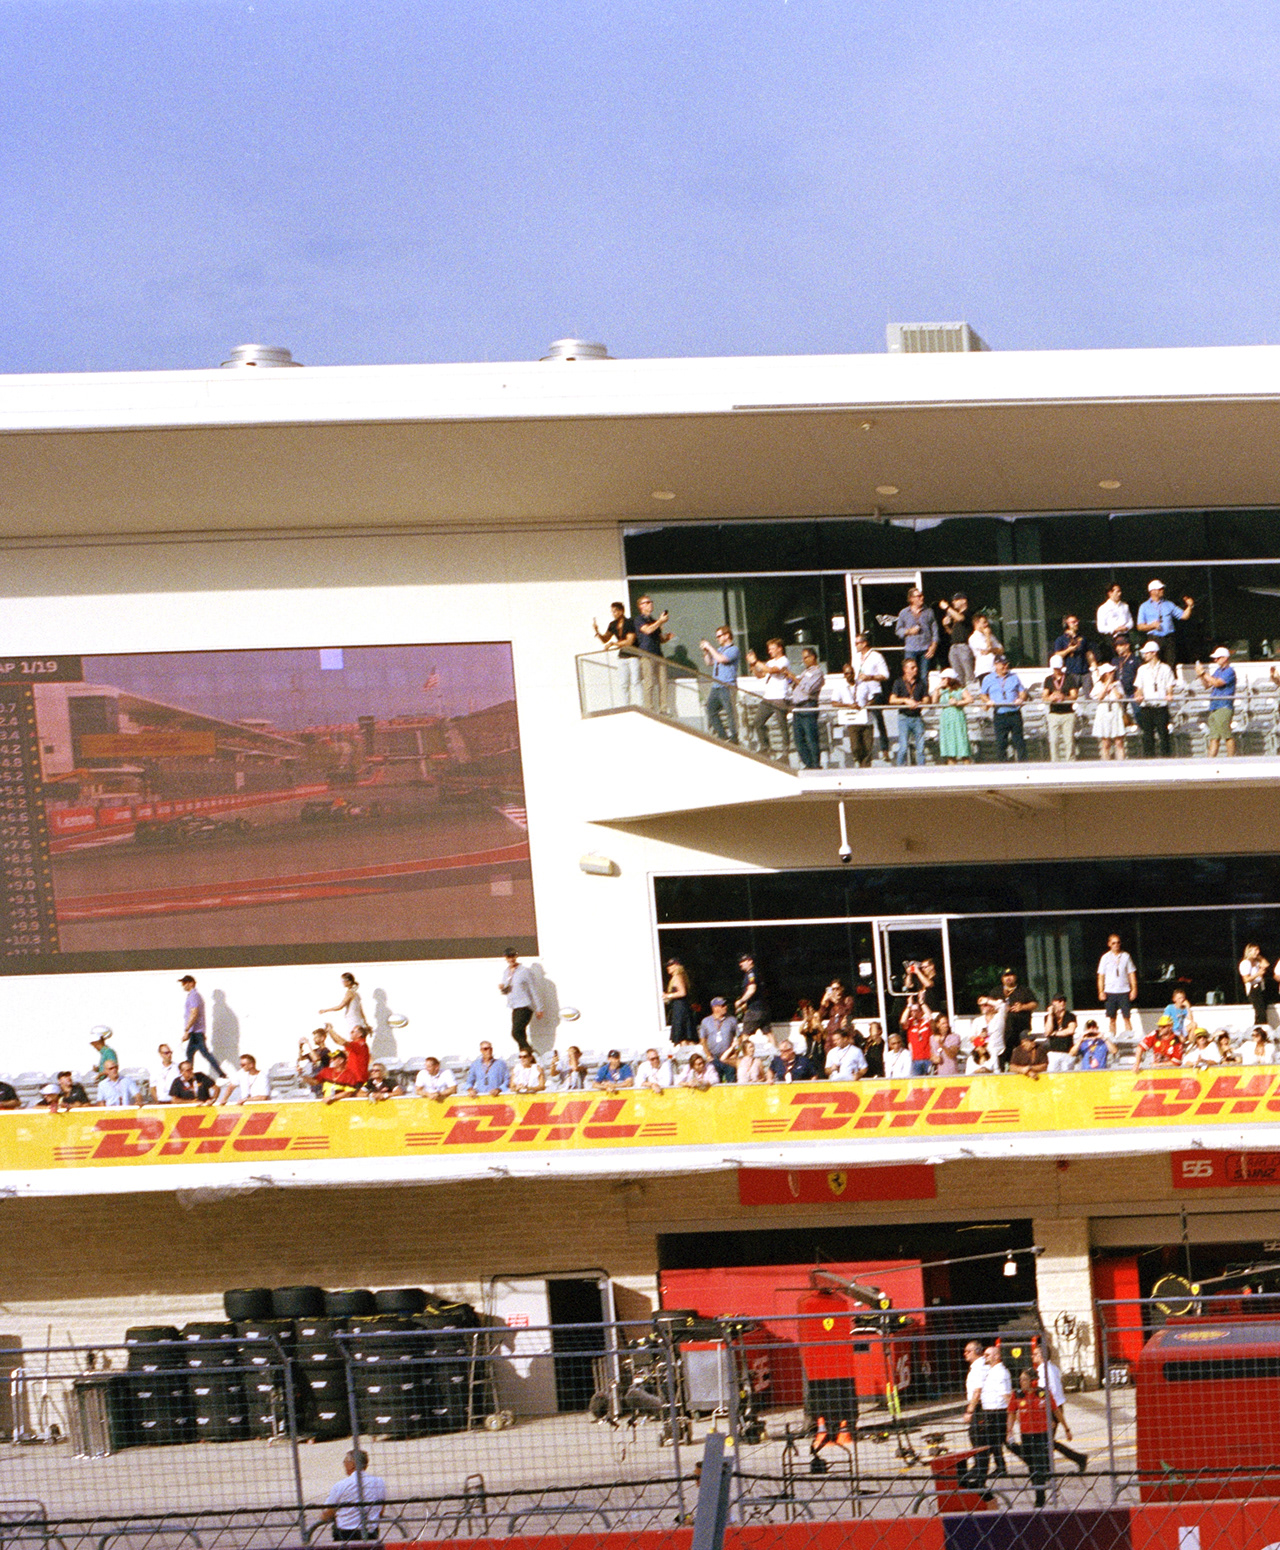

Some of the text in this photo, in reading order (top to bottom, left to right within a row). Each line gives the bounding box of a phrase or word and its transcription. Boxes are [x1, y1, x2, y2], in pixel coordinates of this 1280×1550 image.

[21, 660, 58, 674] 1/19
[443, 1099, 641, 1146] DHL
[787, 1086, 984, 1131] DHL
[92, 1113, 293, 1159] DHL
[1181, 1160, 1214, 1179] 55
